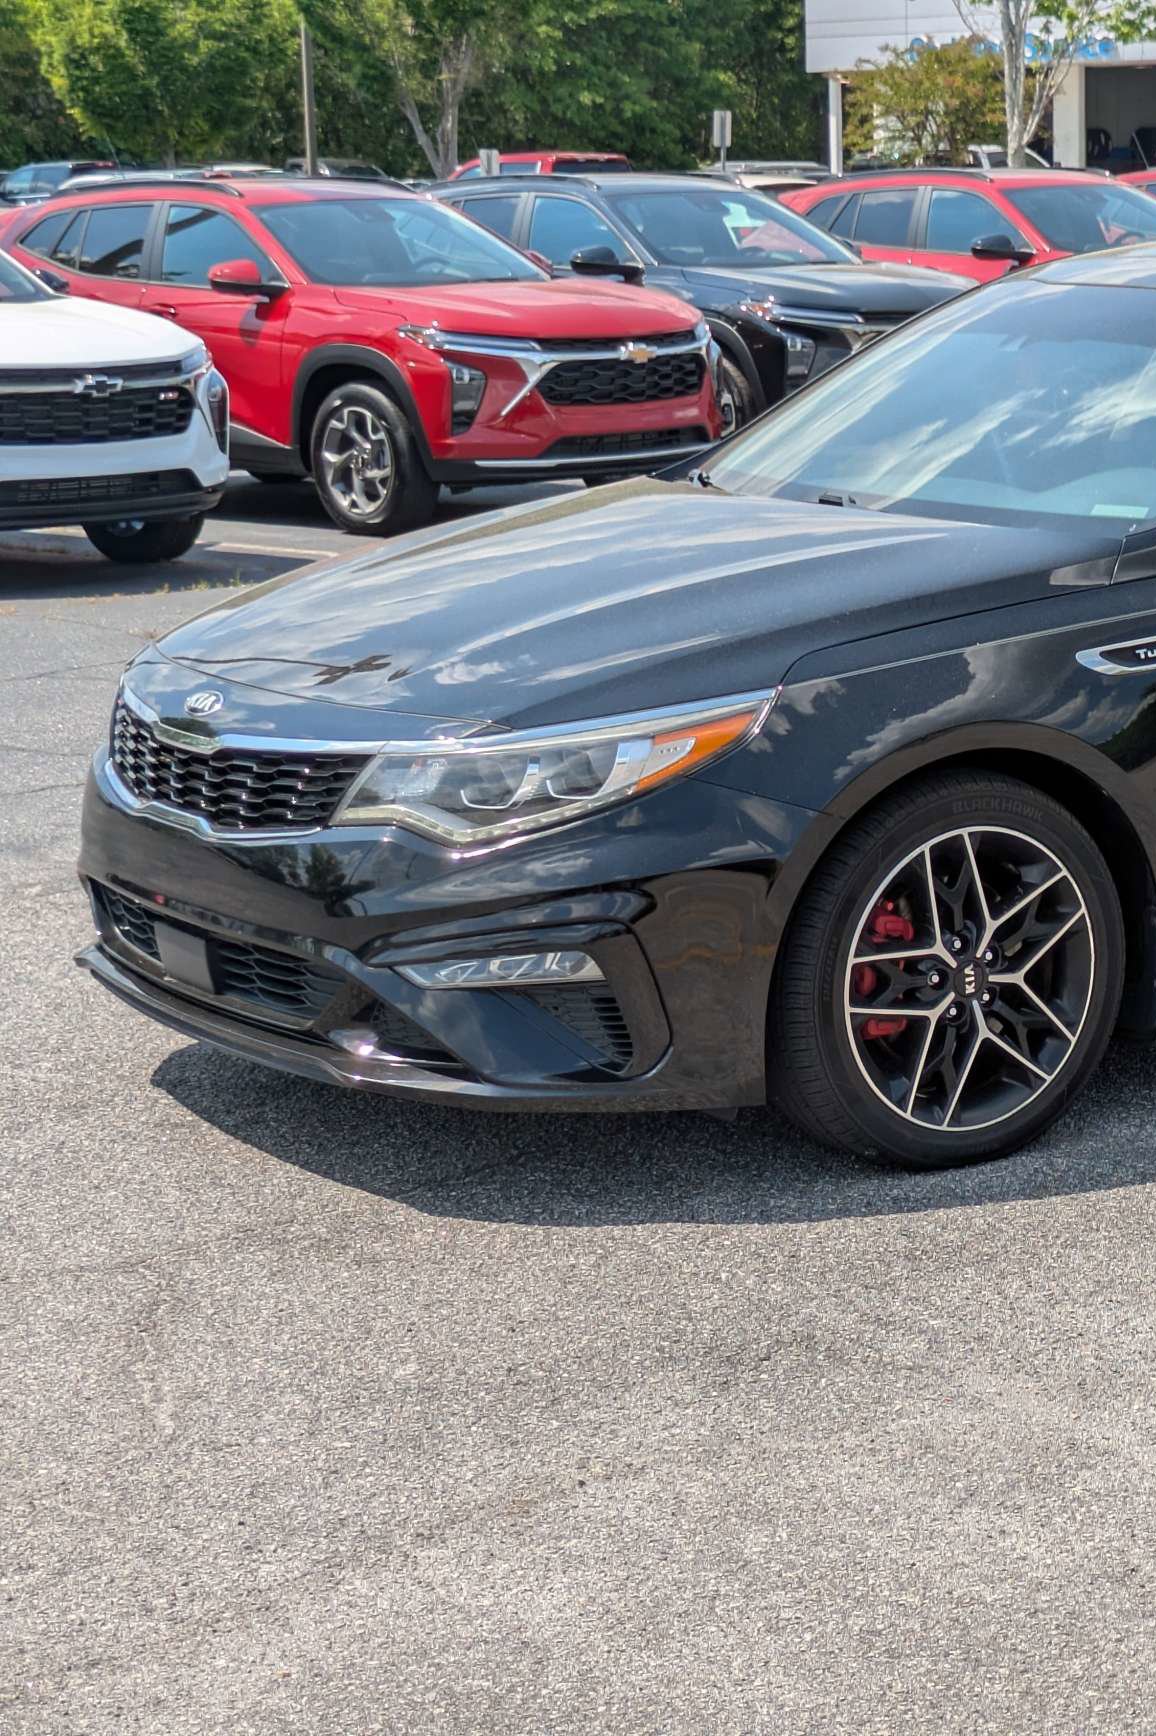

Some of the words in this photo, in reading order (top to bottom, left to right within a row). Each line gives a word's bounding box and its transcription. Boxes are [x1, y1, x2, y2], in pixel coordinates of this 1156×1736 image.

[187, 692, 220, 712] KIA
[952, 797, 1043, 822] BLACKHAWK
[964, 963, 976, 994] KIA
